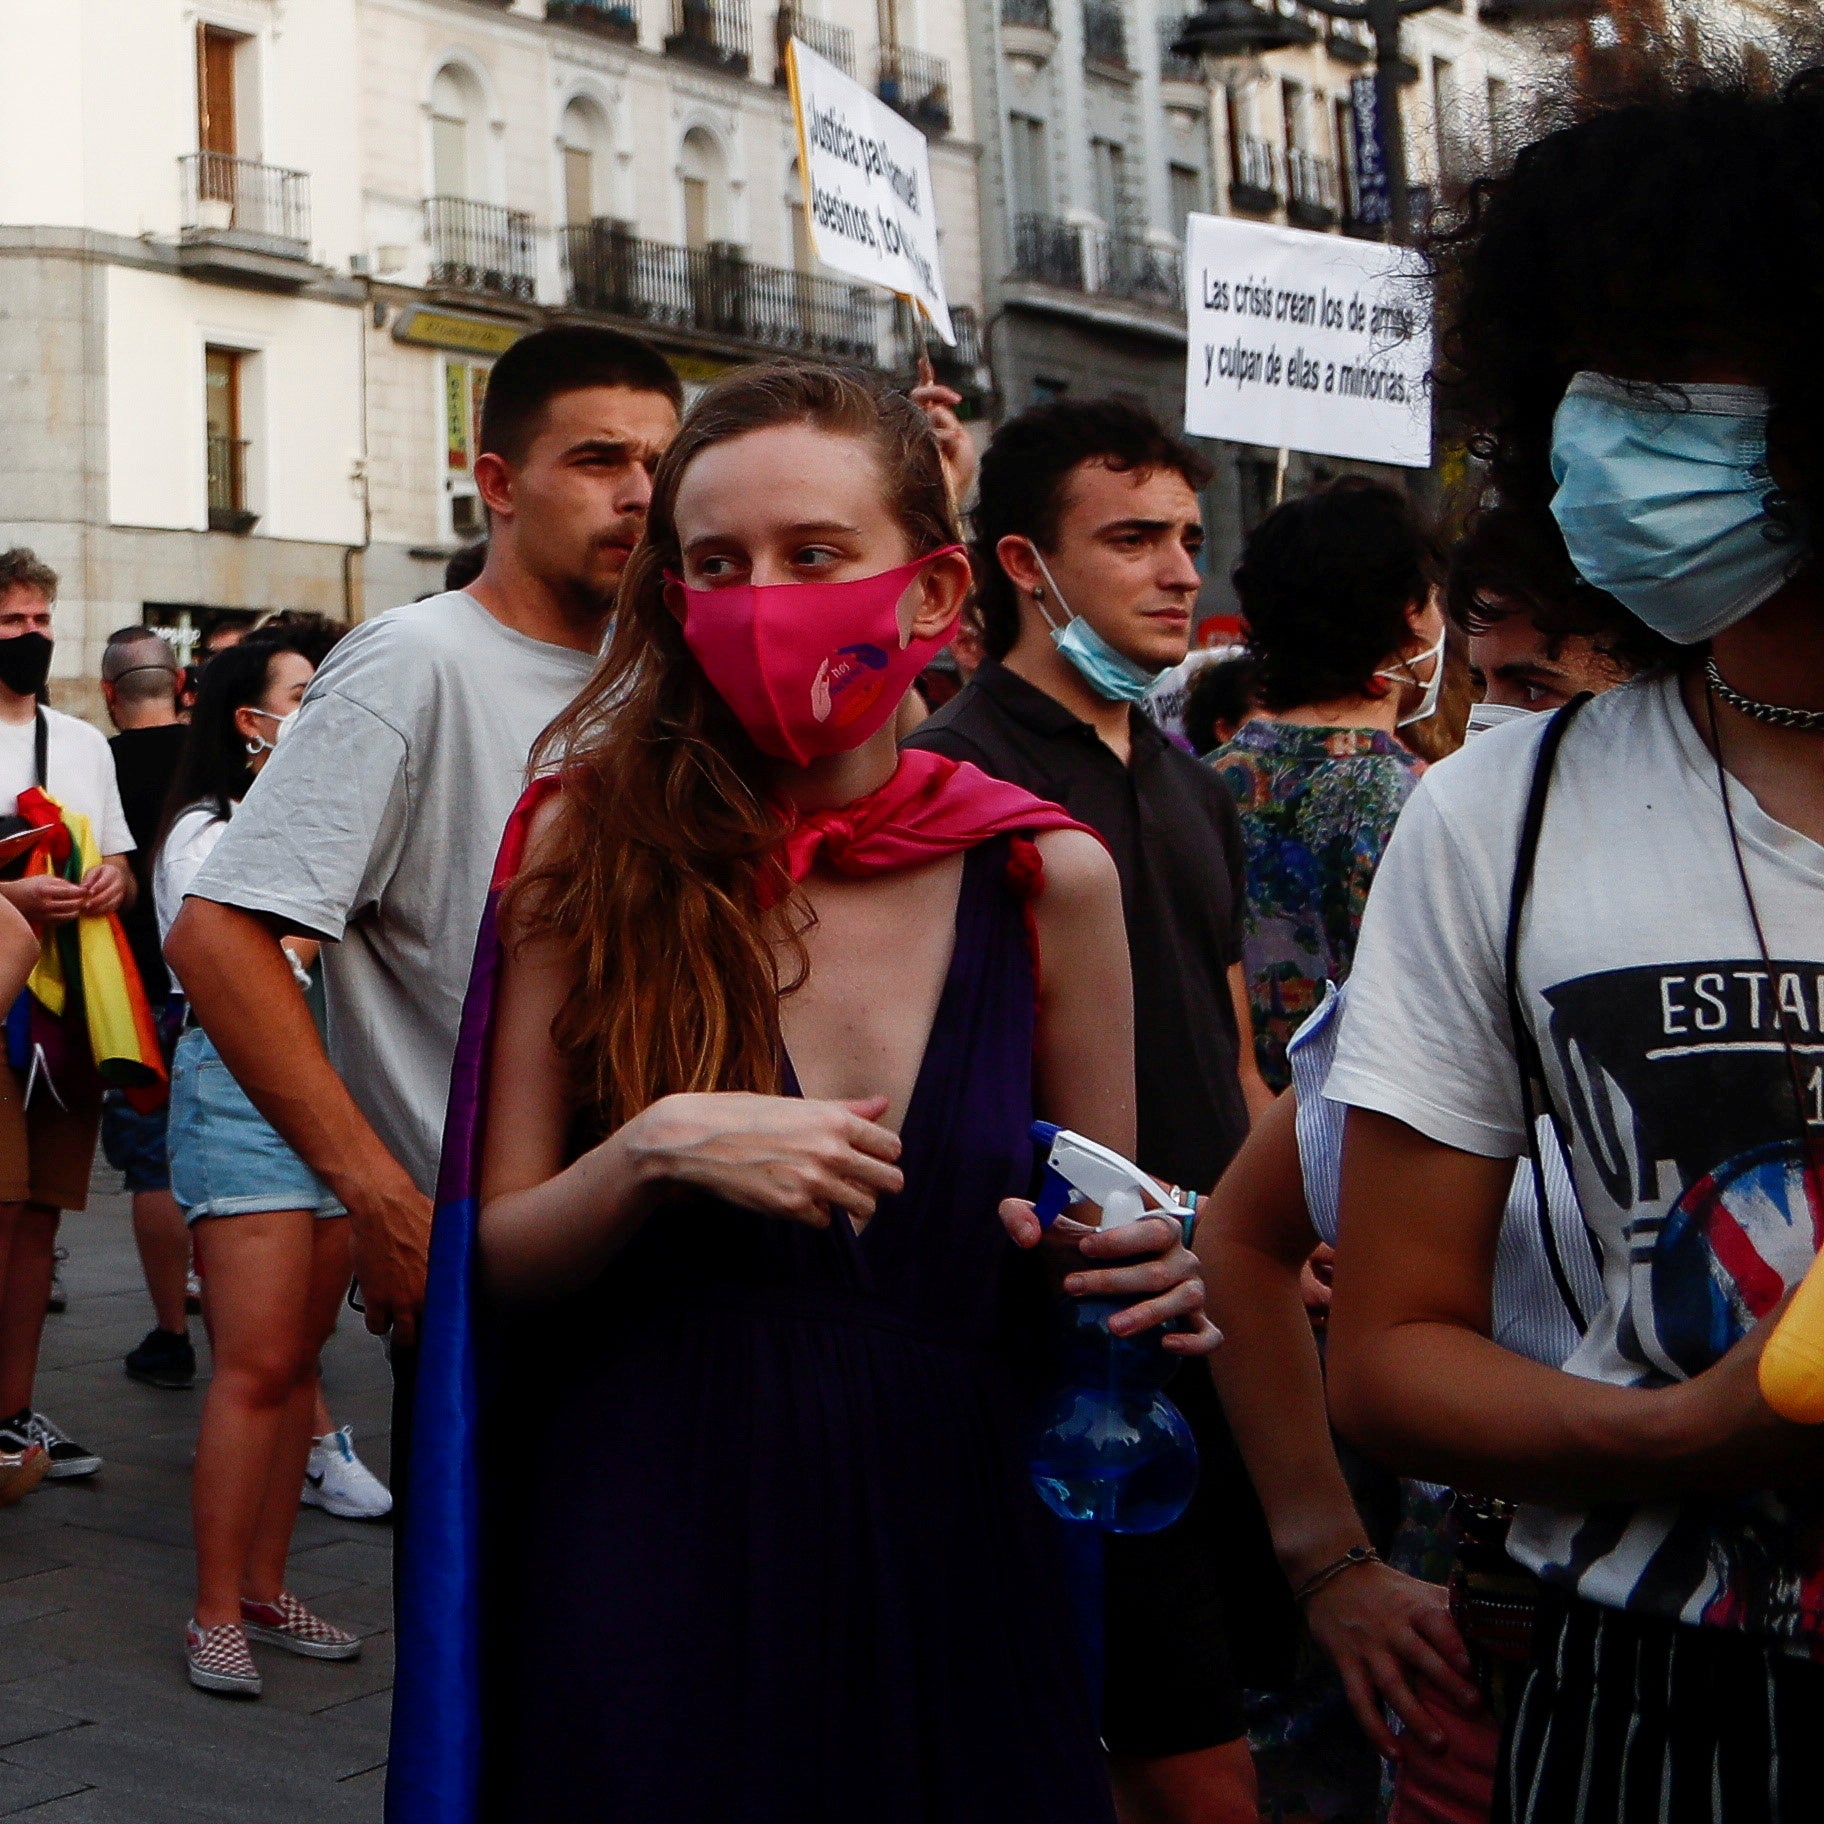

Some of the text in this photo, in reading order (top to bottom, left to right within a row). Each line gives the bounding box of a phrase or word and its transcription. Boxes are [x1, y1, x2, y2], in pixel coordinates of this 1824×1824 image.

[1203, 267, 1229, 311] Las
[1235, 275, 1273, 320] crisis
[1276, 290, 1316, 327] crean
[1321, 286, 1343, 329] los
[1348, 291, 1365, 332] de
[1204, 343, 1214, 387] y
[1219, 336, 1262, 391] culpan
[1265, 343, 1281, 385] de
[1287, 346, 1319, 391] ellas
[1325, 363, 1334, 393] a
[1660, 972, 1824, 1035] ESTA
